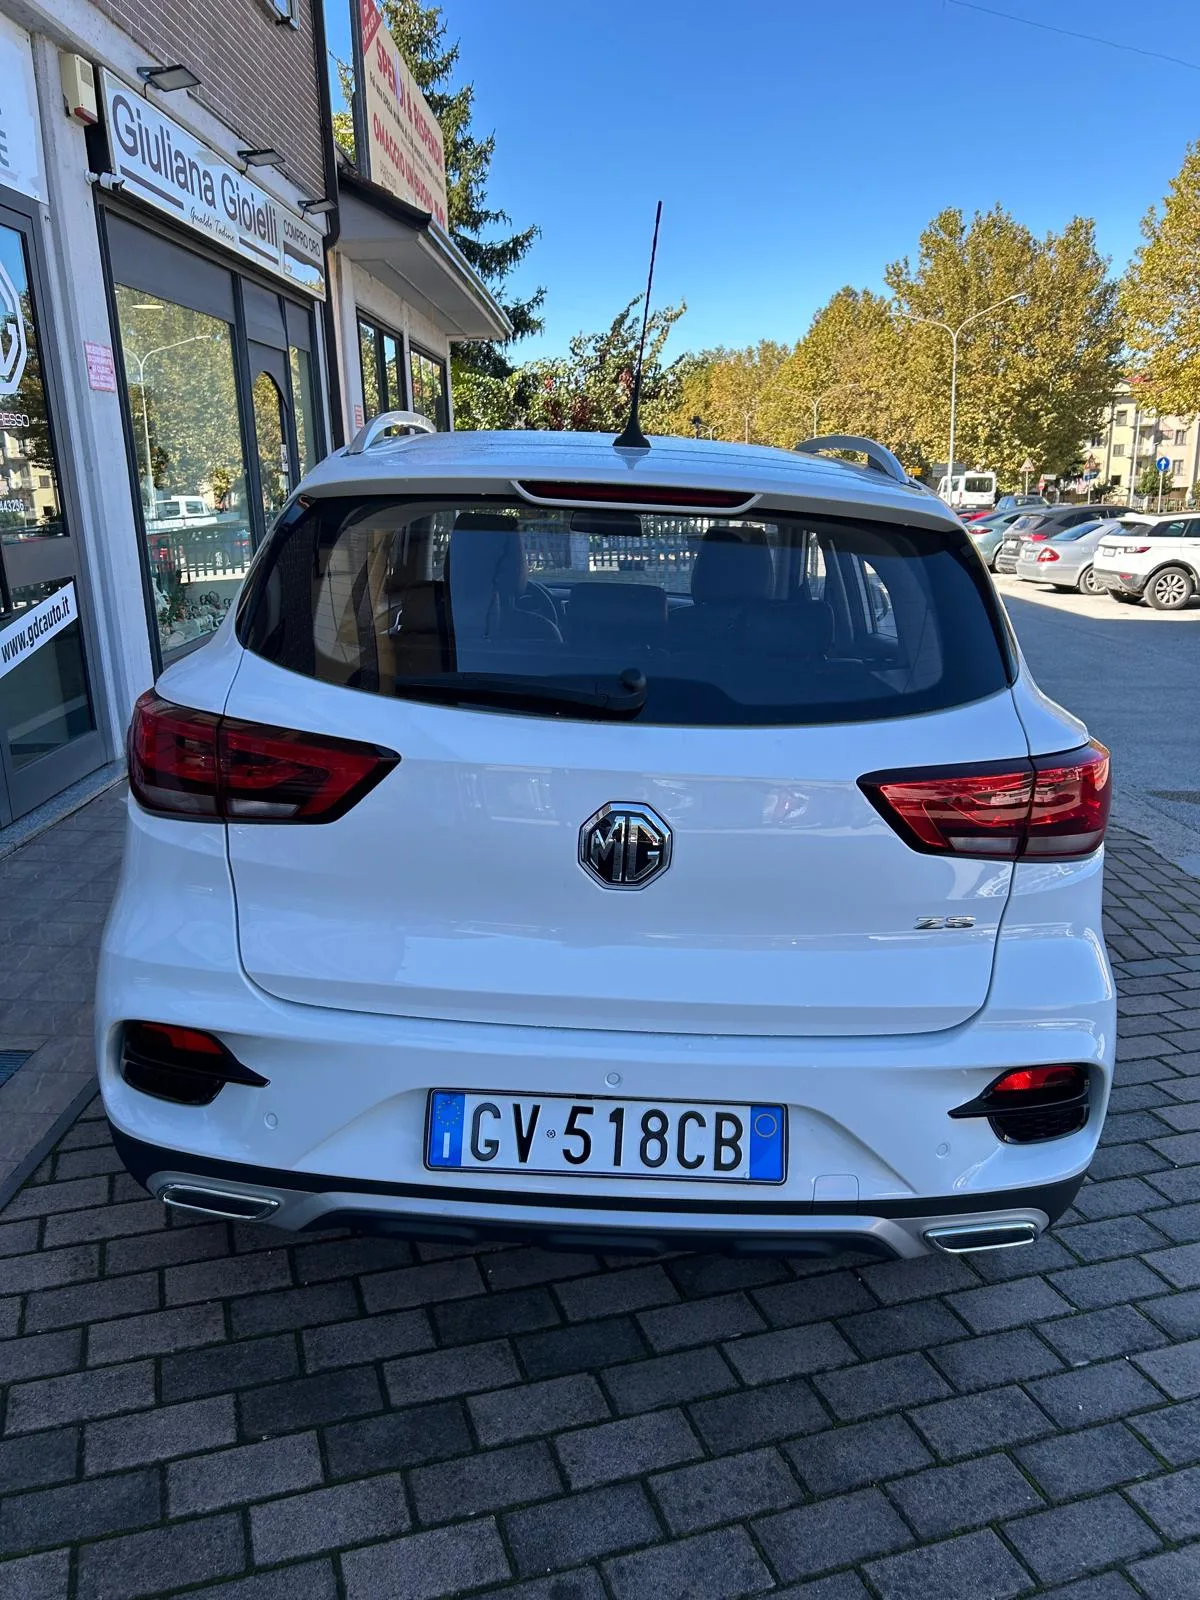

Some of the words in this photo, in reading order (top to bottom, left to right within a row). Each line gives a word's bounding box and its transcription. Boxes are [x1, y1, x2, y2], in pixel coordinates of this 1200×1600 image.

[112, 94, 217, 210] Giuliana
[220, 173, 279, 249] Gioielli
[283, 219, 308, 249] COMPRO
[308, 239, 321, 258] ORO
[1, 595, 70, 663] www.gdcauto.it
[590, 815, 661, 881] MG
[914, 915, 977, 930] ZS
